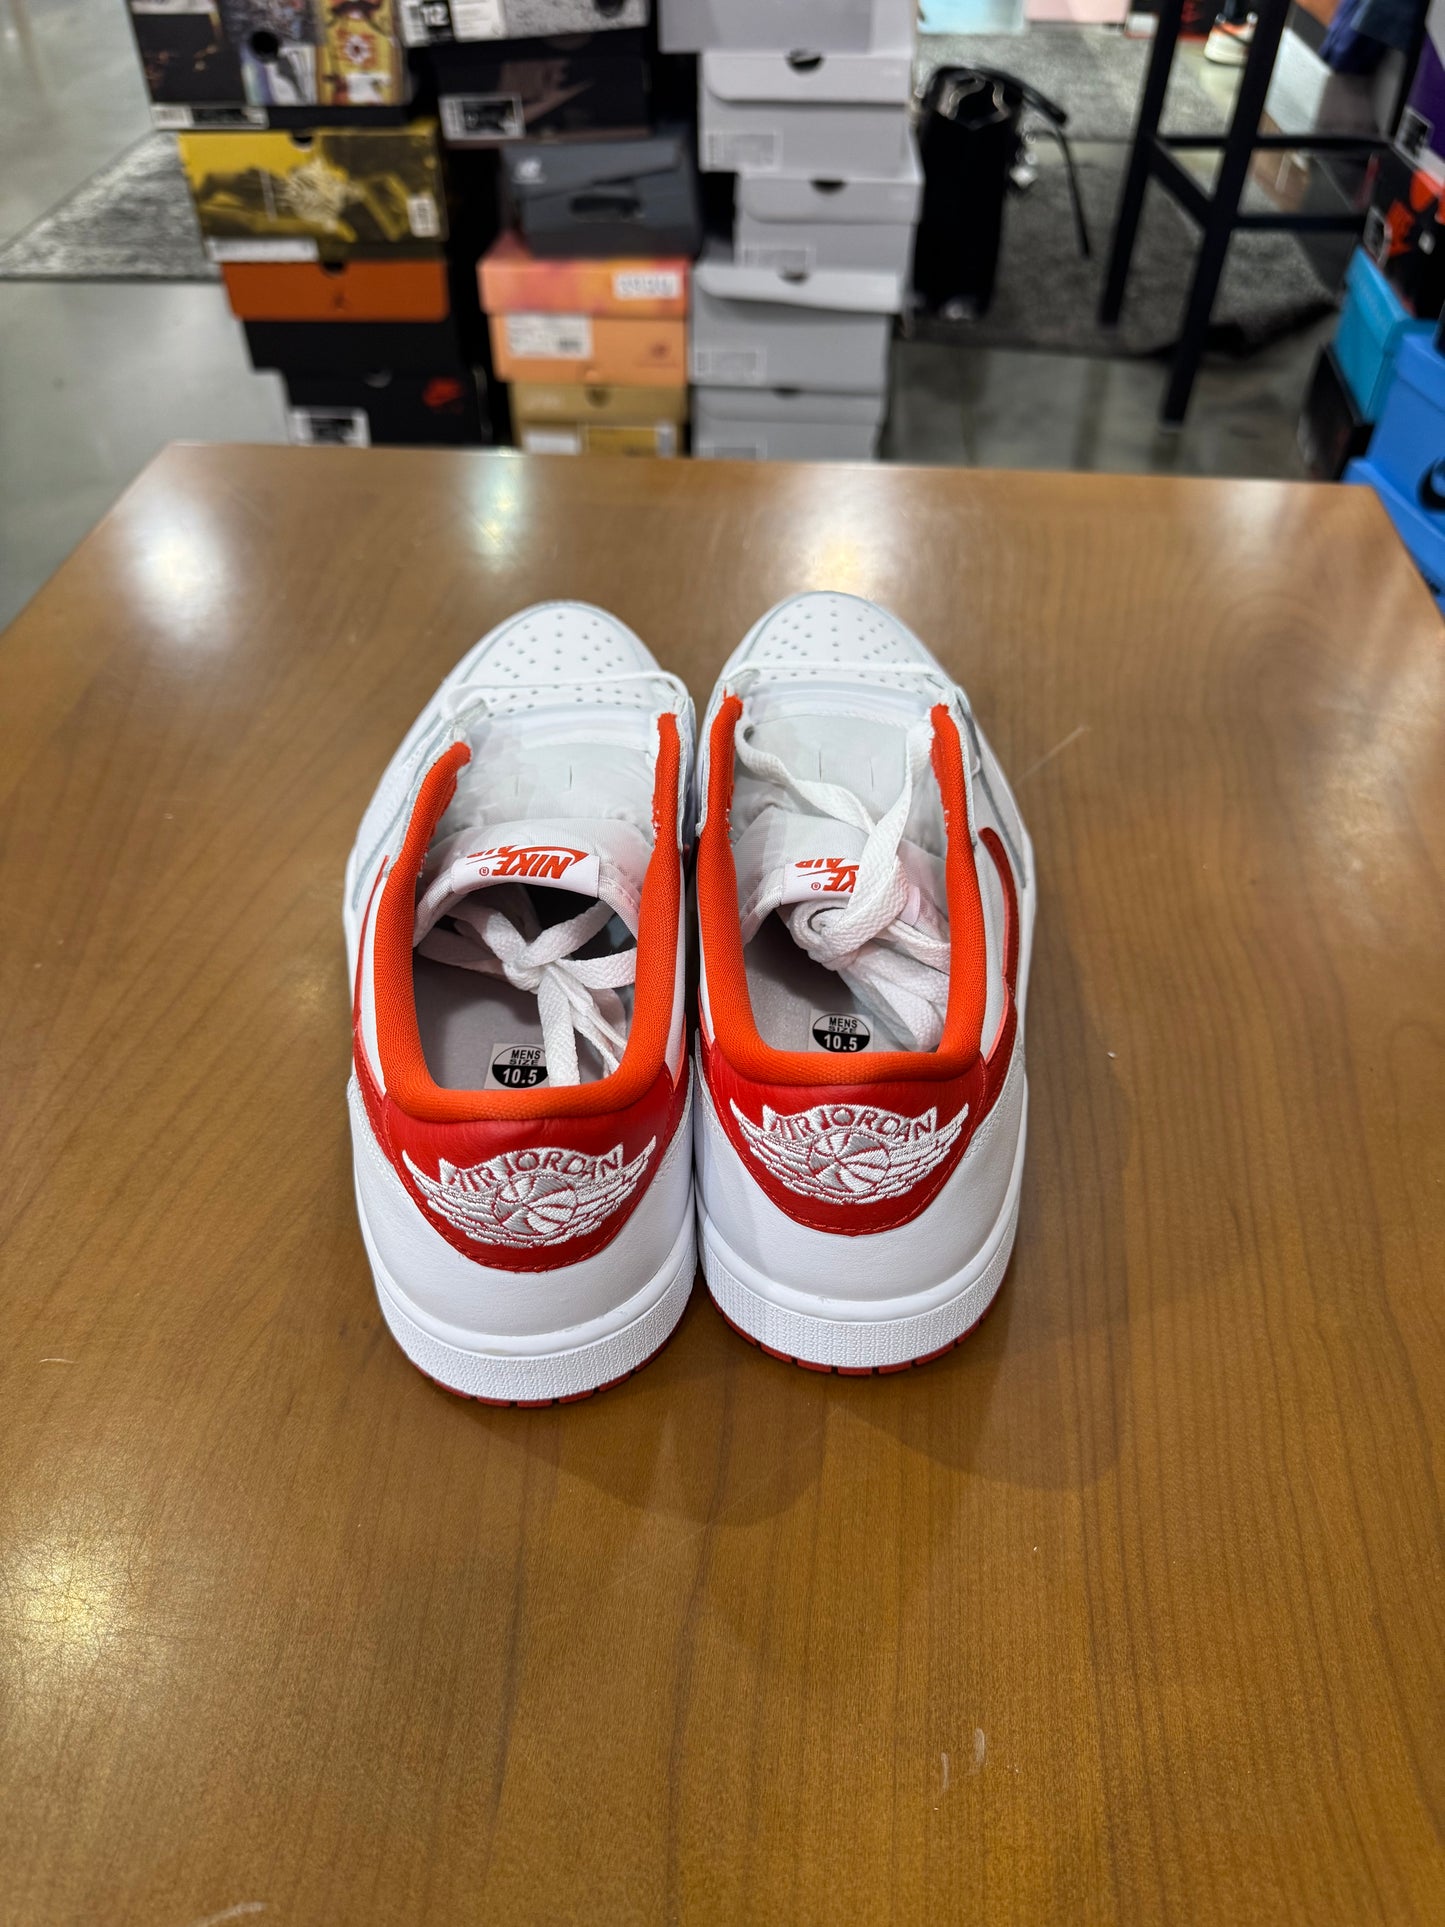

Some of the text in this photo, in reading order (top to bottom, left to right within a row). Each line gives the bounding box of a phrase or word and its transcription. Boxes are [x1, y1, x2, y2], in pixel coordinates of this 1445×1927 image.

[491, 852, 573, 879] NIKE
[828, 1016, 858, 1029] MENS
[828, 1026, 857, 1035] SIZE
[824, 1033, 858, 1051] 10.5
[511, 1049, 541, 1060] MENS
[503, 1067, 538, 1084] 10.5
[770, 1106, 933, 1142] AIR JORDAN
[450, 1150, 620, 1193] AIR JORDAN
